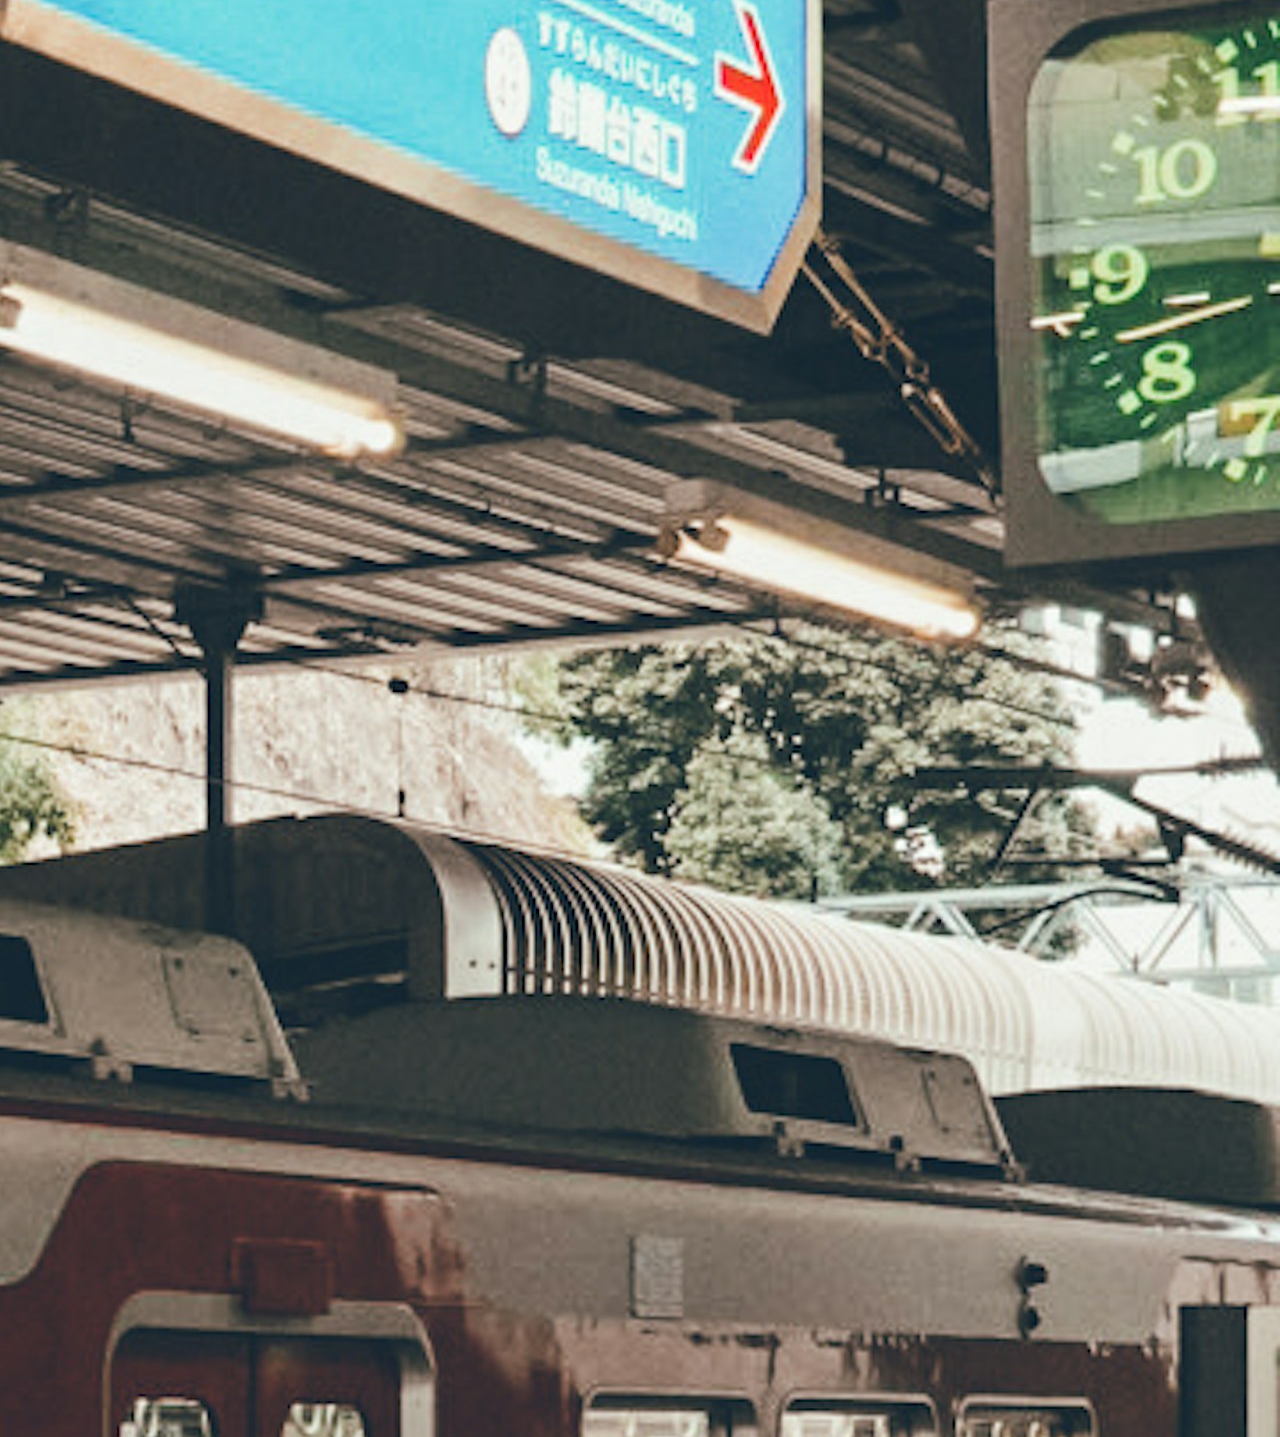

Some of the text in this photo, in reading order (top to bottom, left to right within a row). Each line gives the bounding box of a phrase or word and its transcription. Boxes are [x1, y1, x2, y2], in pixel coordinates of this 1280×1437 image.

[547, 66, 686, 189] 鈴蘭台西口
[1133, 139, 1217, 205] 10
[1091, 242, 1149, 306] 9
[1138, 340, 1196, 403] 8
[1230, 396, 1280, 458] 7
